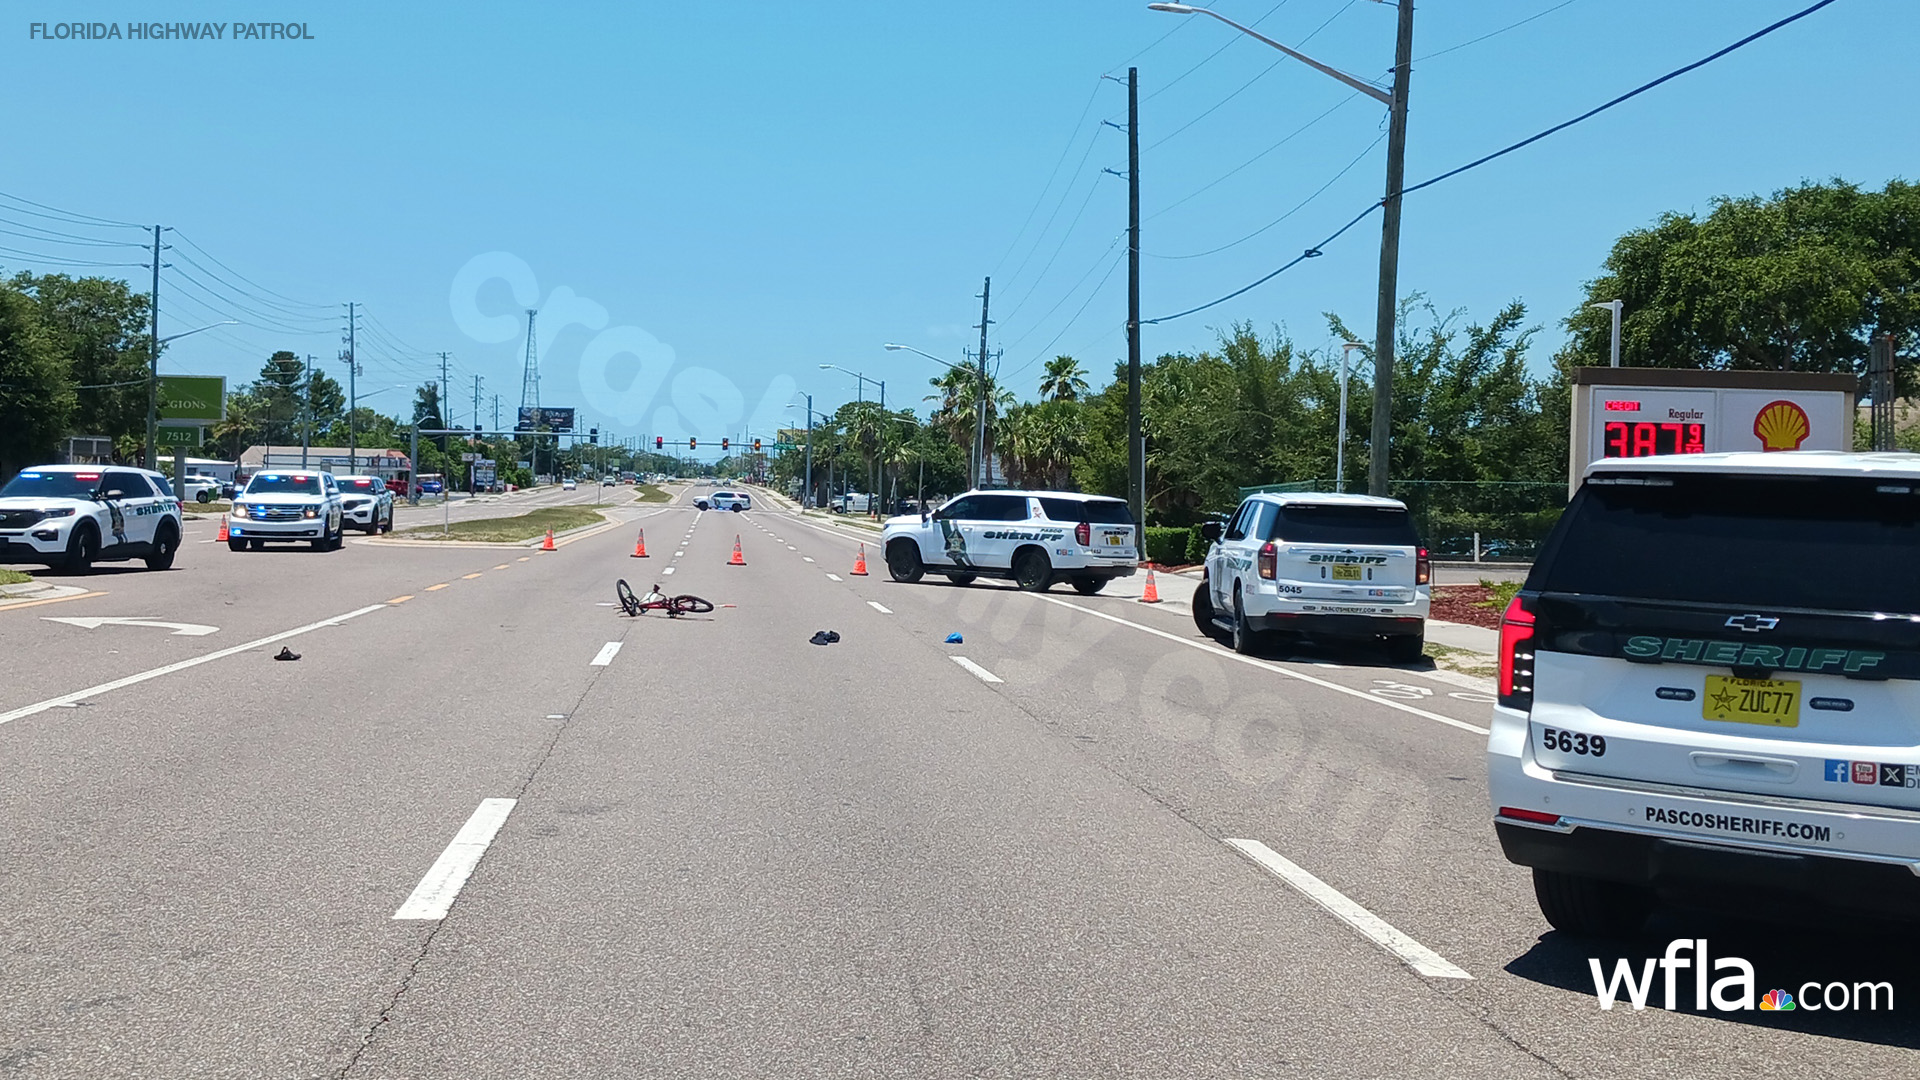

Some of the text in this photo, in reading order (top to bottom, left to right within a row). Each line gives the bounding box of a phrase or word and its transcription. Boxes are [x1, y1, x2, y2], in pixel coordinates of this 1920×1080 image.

[166, 400, 207, 409] GIONS
[1606, 401, 1639, 410] CREDIT
[1668, 408, 1704, 421] Regular
[166, 431, 192, 441] 7512
[983, 531, 1064, 541] SHERIFF
[1309, 554, 1387, 564] SHERIFF
[1279, 585, 1302, 594] 5045
[1321, 605, 1377, 613] PASCOSHERIFF.COM
[1623, 635, 1886, 672] SHERIFF
[1730, 679, 1775, 688] FLORIDA
[1739, 689, 1794, 715] ZUC77
[1543, 728, 1607, 757] 5639
[1646, 806, 1831, 842] PASCOSHERIFF.COM
